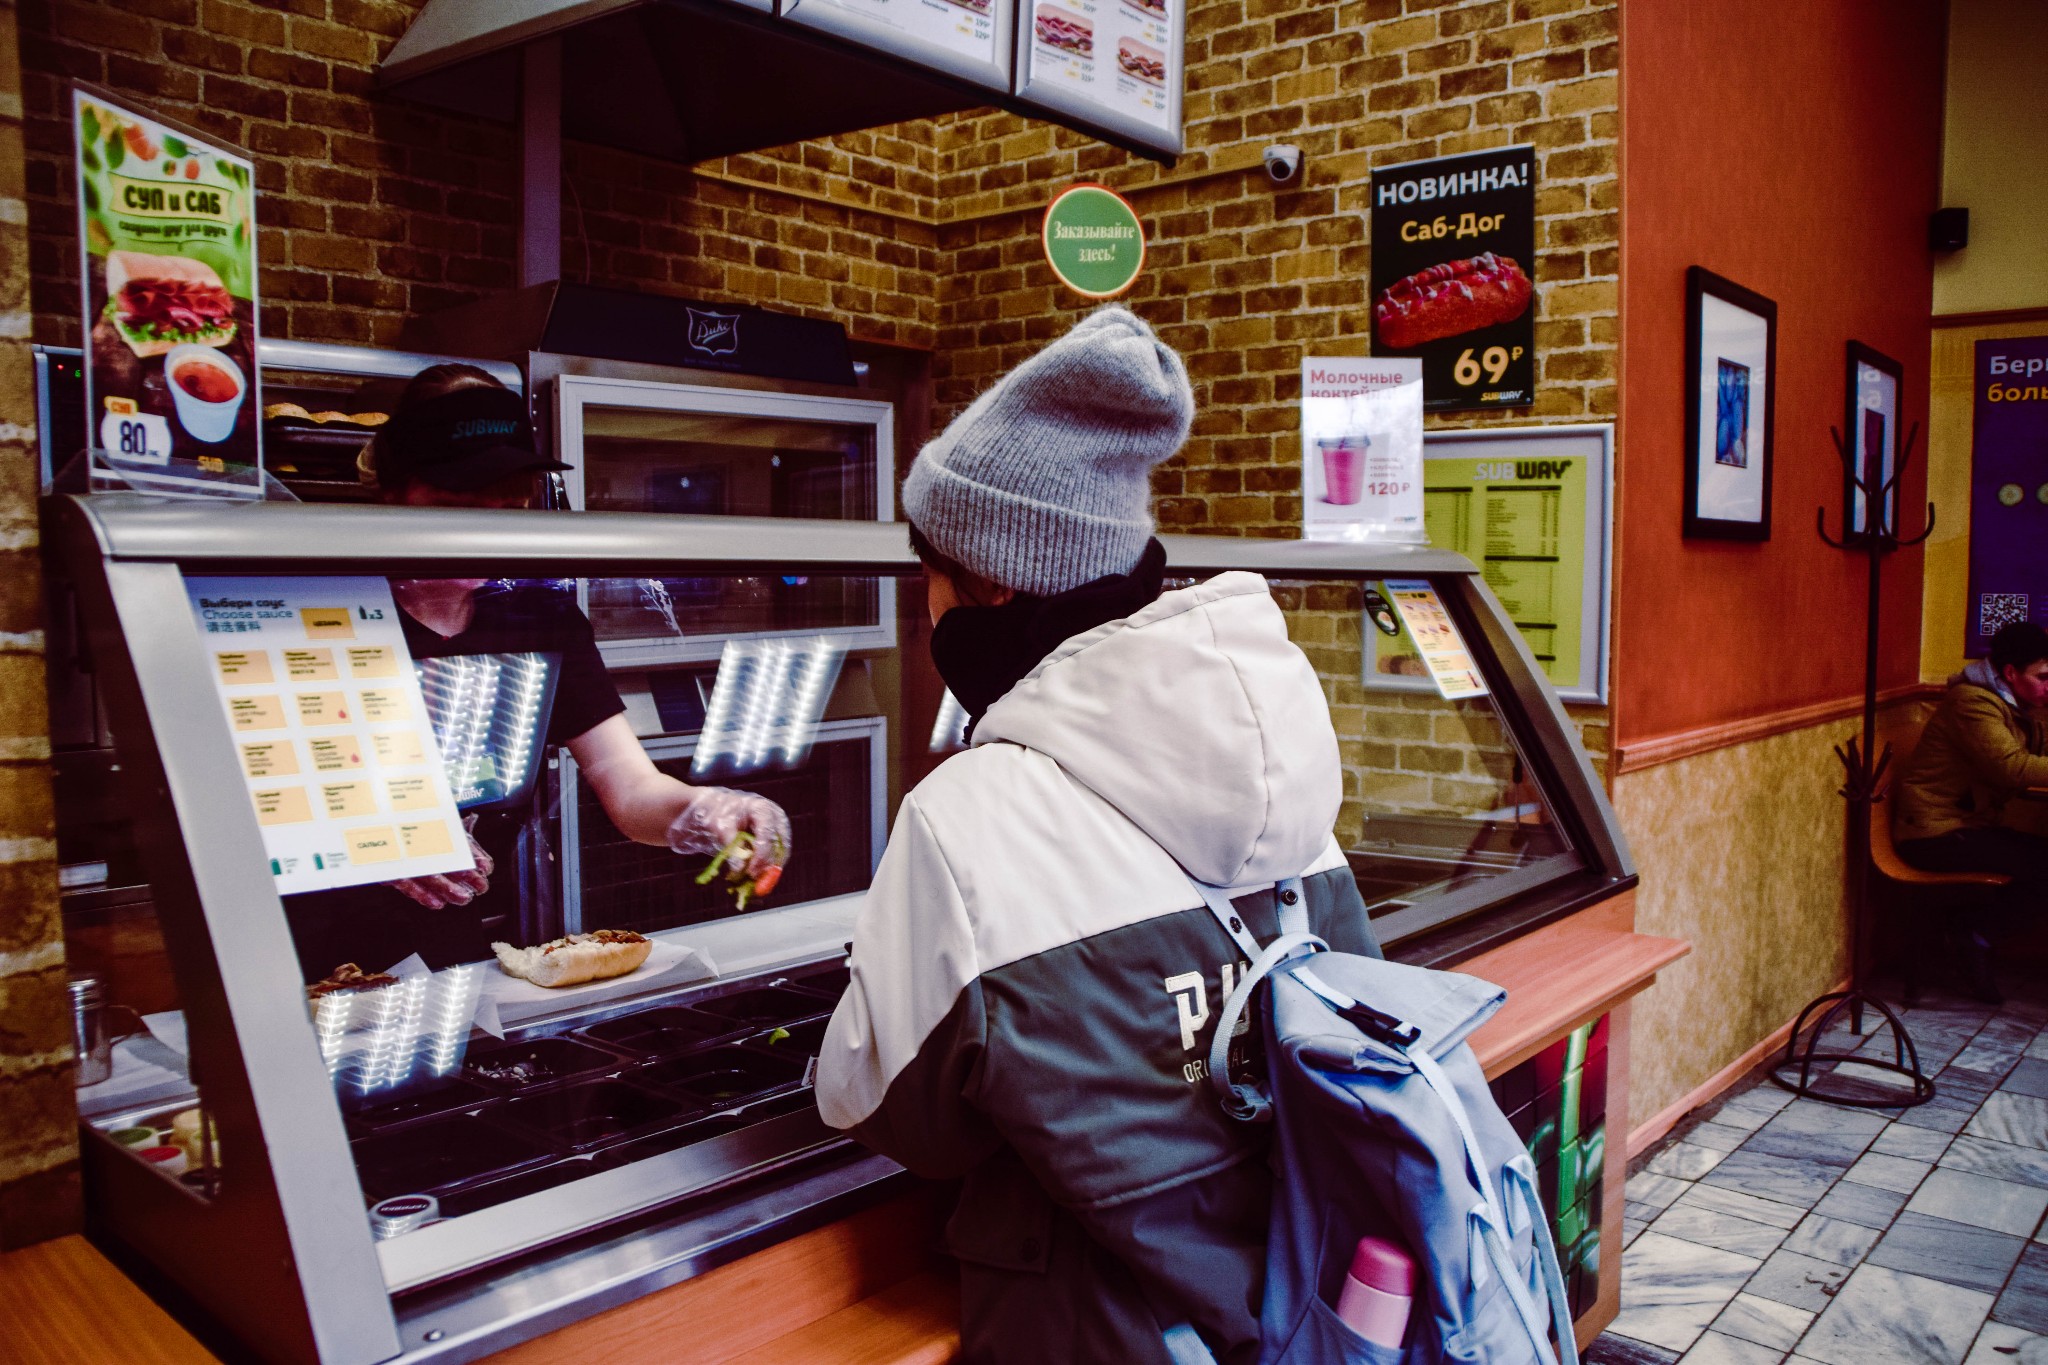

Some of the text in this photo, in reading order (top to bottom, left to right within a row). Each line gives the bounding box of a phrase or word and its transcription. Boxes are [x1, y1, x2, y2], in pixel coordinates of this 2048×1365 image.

[1378, 163, 1529, 206] НОВИНКА!
[124, 185, 164, 210] СУП
[185, 190, 221, 215] САБ
[1054, 221, 1135, 239] Заказывайте
[1401, 212, 1505, 242] Саб-Дог
[1079, 244, 1116, 263] здесь!
[695, 319, 730, 342] Duke
[1311, 369, 1403, 384] Молочные
[1481, 390, 1524, 401] SUBWAY
[120, 420, 146, 456] 80
[452, 419, 518, 438] SUBWAY
[1473, 459, 1572, 480] SUBWAY
[200, 598, 286, 609] Выбери соус
[202, 609, 293, 620] Choose sauce
